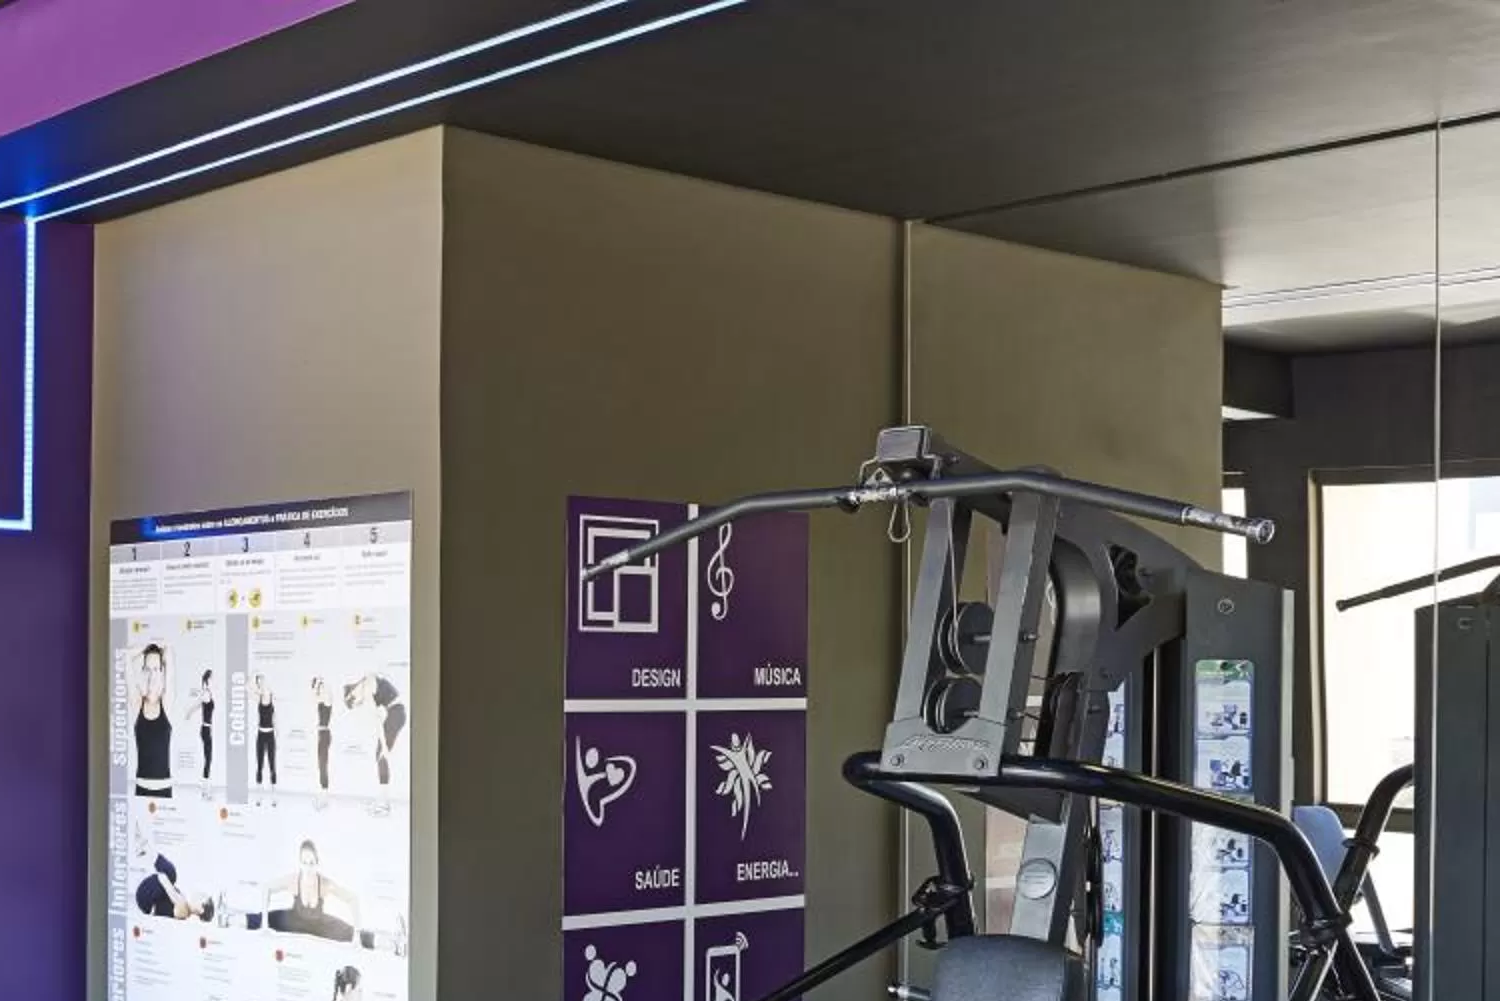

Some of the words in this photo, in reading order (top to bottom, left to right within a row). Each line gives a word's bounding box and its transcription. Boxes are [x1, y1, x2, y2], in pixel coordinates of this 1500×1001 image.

[631, 667, 681, 688] DESIGN
[753, 663, 802, 686] MÚSICA
[634, 864, 681, 890] SAÚDE
